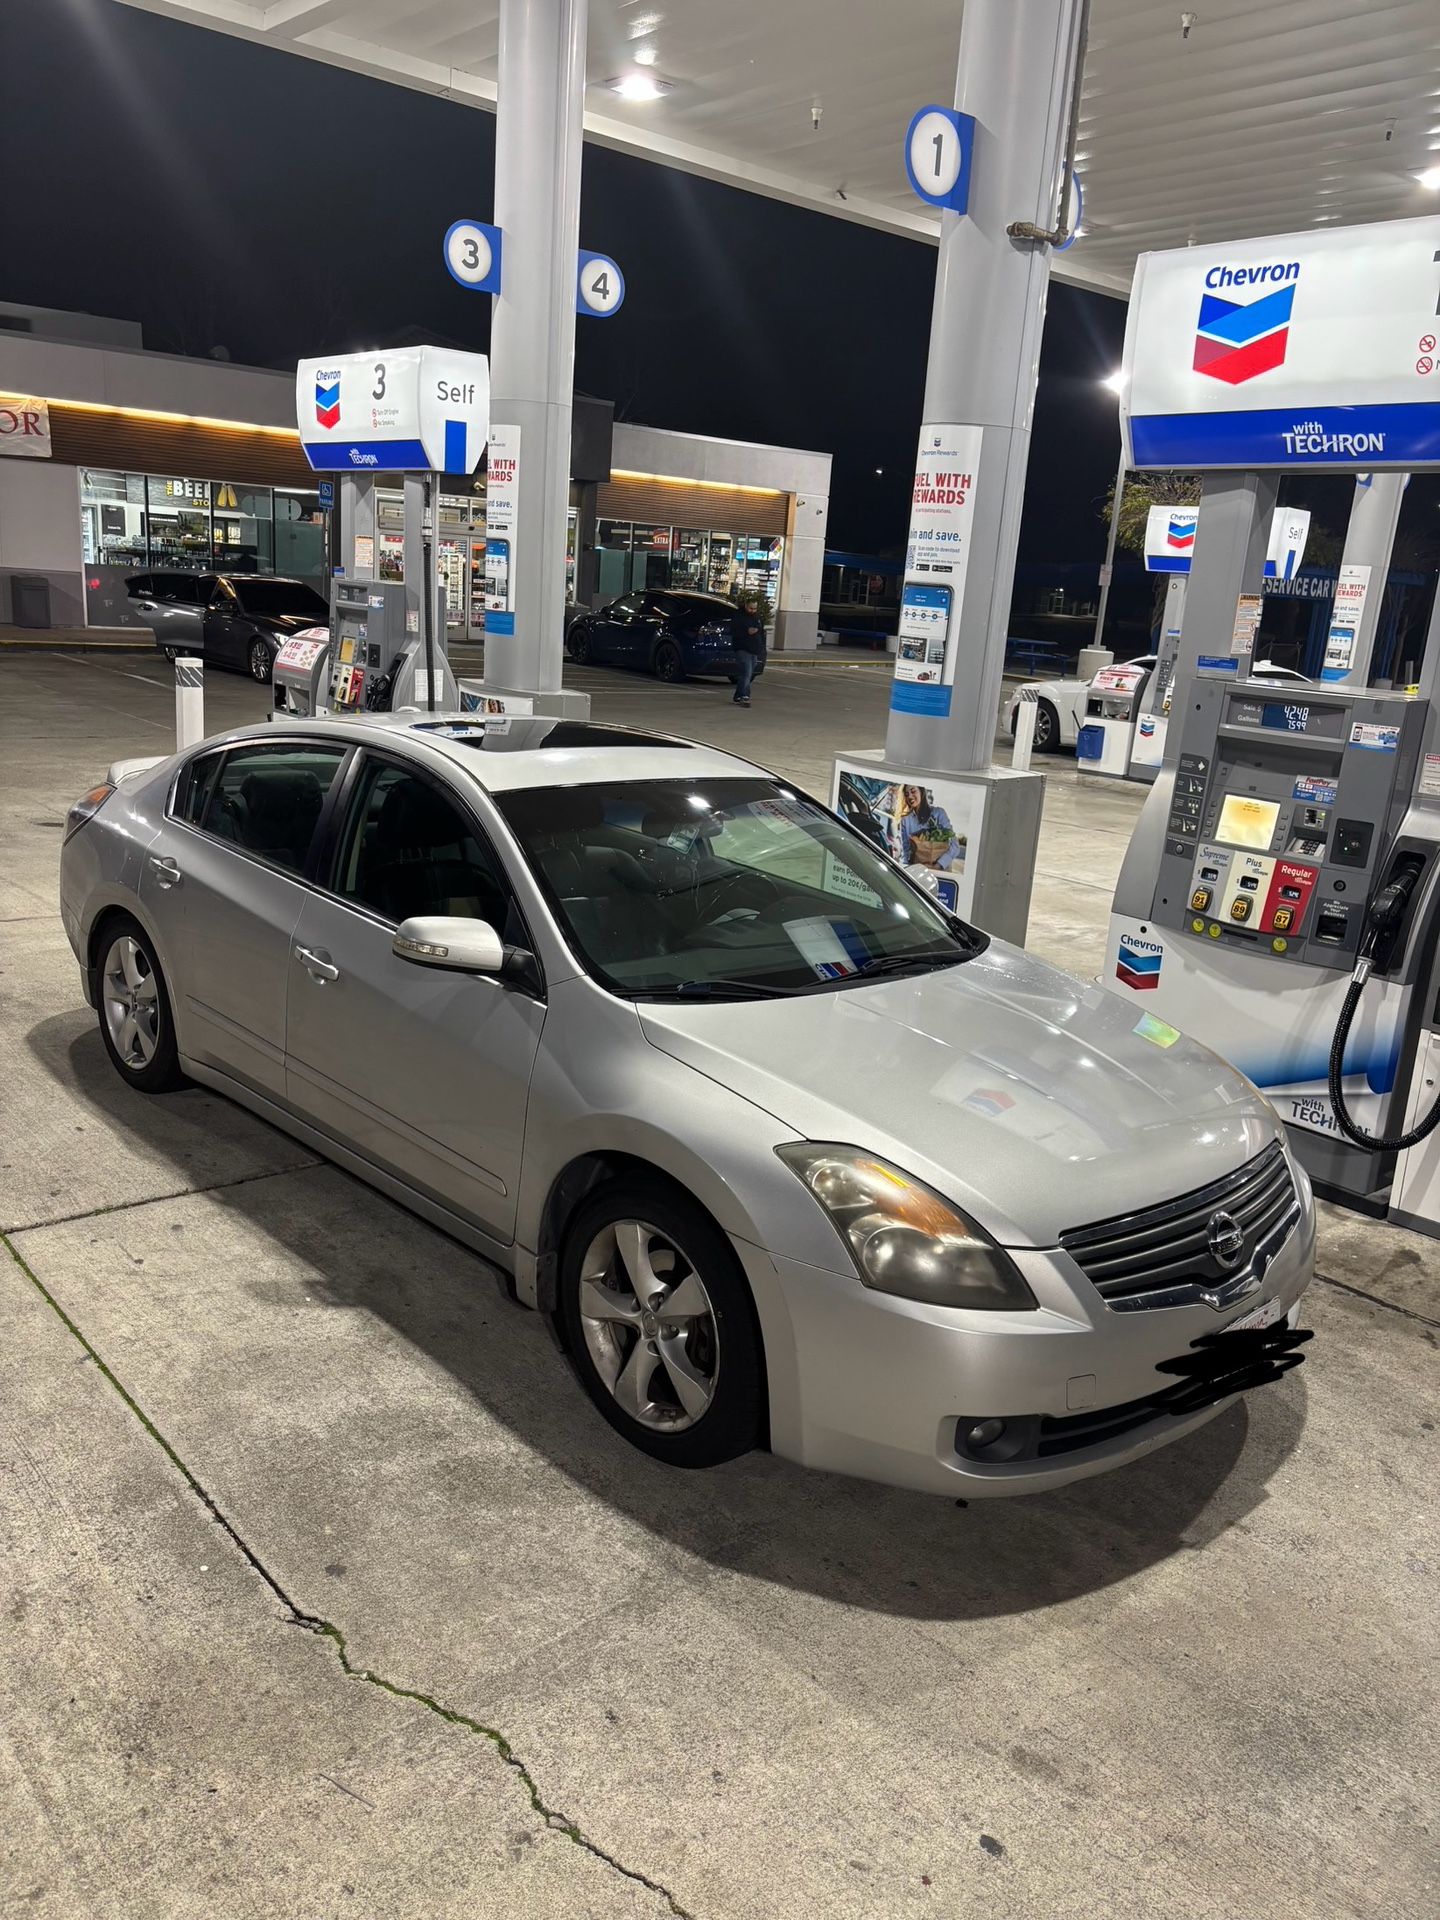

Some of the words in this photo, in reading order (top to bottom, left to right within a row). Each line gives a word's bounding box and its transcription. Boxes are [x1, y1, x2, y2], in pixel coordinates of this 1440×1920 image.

[933, 133, 943, 176] 1
[462, 239, 479, 269] 3
[1205, 262, 1300, 288] Chevron
[591, 272, 609, 299] 4
[316, 370, 341, 381] Chevron
[373, 363, 386, 400] 3
[437, 381, 475, 404] Self
[1293, 421, 1323, 434] with
[494, 458, 516, 470] WITH
[935, 472, 972, 489] WITH
[496, 500, 513, 508] save.
[919, 529, 933, 540] and
[935, 531, 962, 542] save.
[1288, 527, 1303, 540] Self
[1266, 577, 1310, 596] SERVICE
[1310, 577, 1329, 598] CAR
[1349, 583, 1366, 591] WITH
[1243, 703, 1256, 711] Sale
[1237, 714, 1260, 723] Gallons
[1200, 846, 1230, 861] Supreme
[1246, 857, 1263, 868] Plus
[1281, 865, 1313, 878] Regular
[1194, 895, 1206, 905] 91
[1233, 904, 1246, 914] 89
[1275, 914, 1289, 924] 87
[1120, 934, 1163, 954] Chevron
[1301, 1098, 1324, 1112] with
